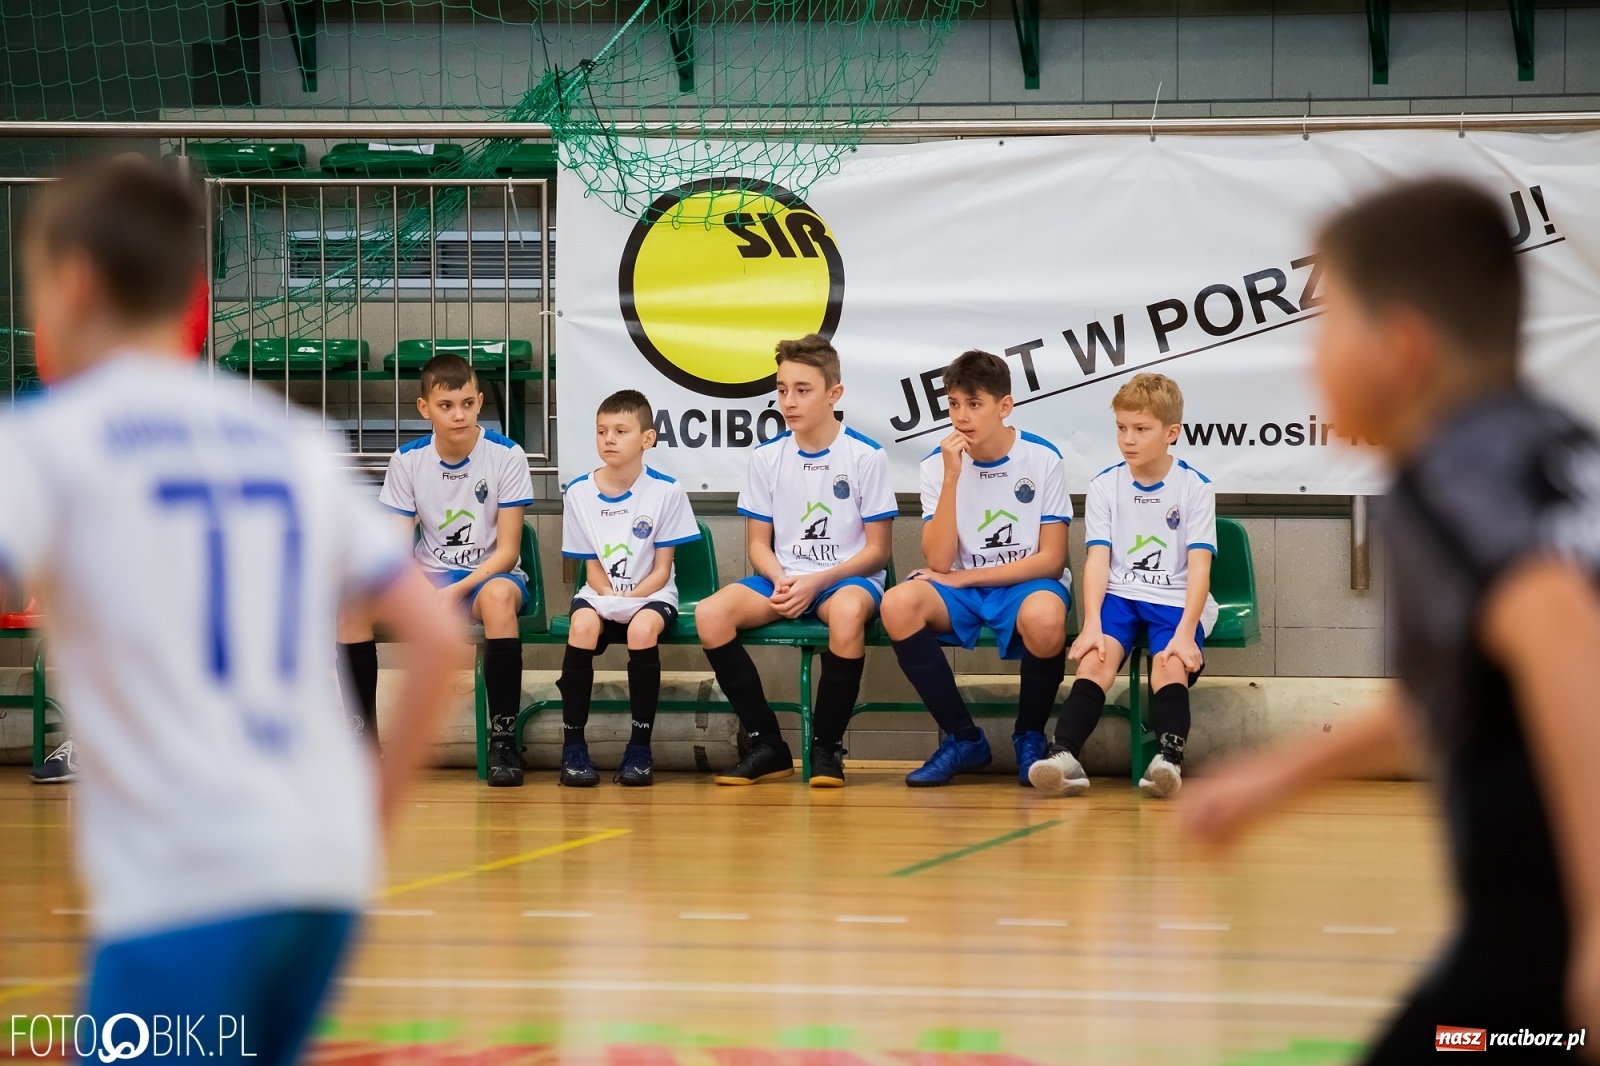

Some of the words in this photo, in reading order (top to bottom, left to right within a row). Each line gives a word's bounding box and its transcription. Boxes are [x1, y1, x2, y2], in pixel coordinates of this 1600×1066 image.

[889, 338, 1044, 432] JET
[1061, 313, 1126, 377] W
[970, 547, 1032, 568] D-ART
